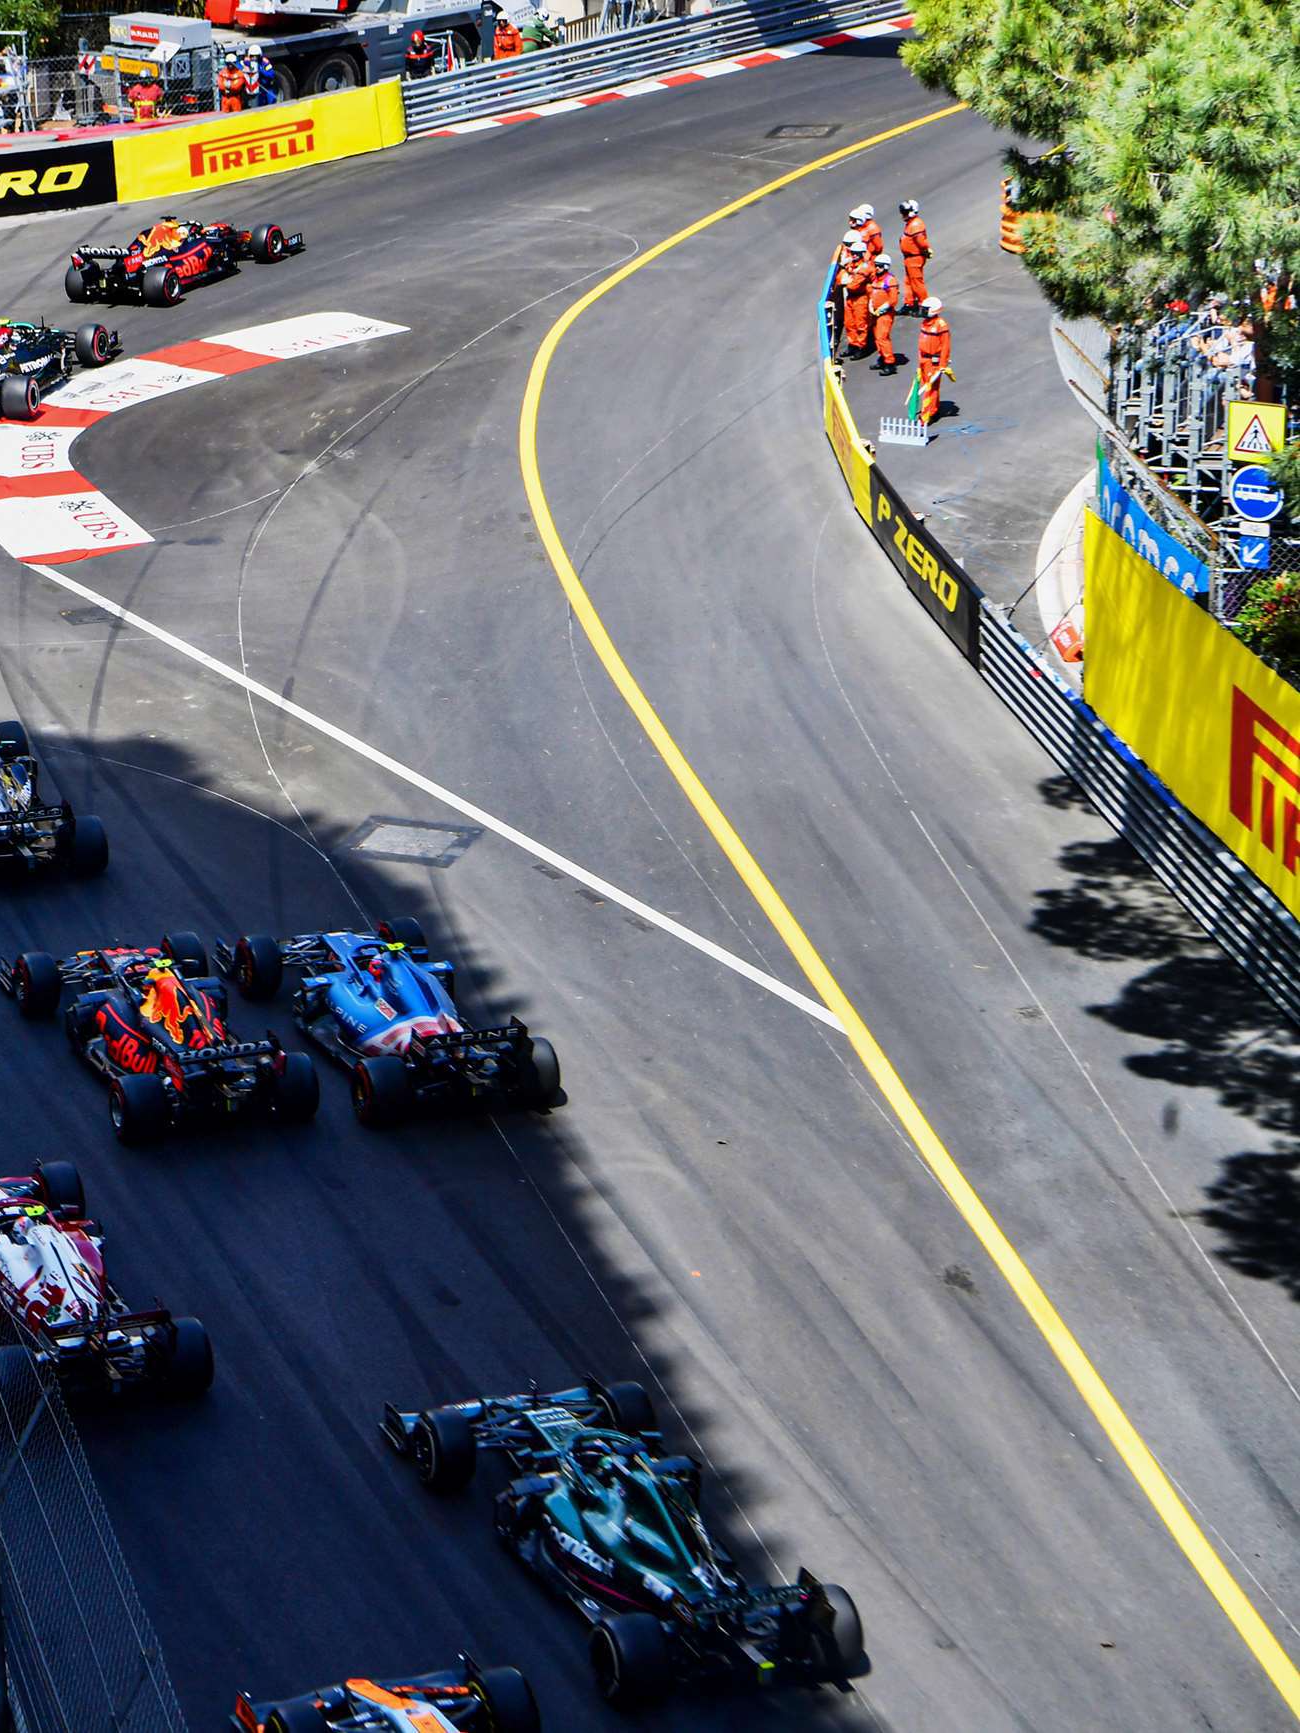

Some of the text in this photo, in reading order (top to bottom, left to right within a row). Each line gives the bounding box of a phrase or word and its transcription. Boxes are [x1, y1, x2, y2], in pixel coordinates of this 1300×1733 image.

[188, 118, 315, 178] PIRELLI
[79, 246, 130, 257] HONDA
[21, 443, 55, 469] UBS
[73, 511, 129, 540] UBS
[877, 493, 959, 612] P ZERO
[428, 1027, 520, 1047] ALPINE
[178, 1040, 274, 1062] HONDA
